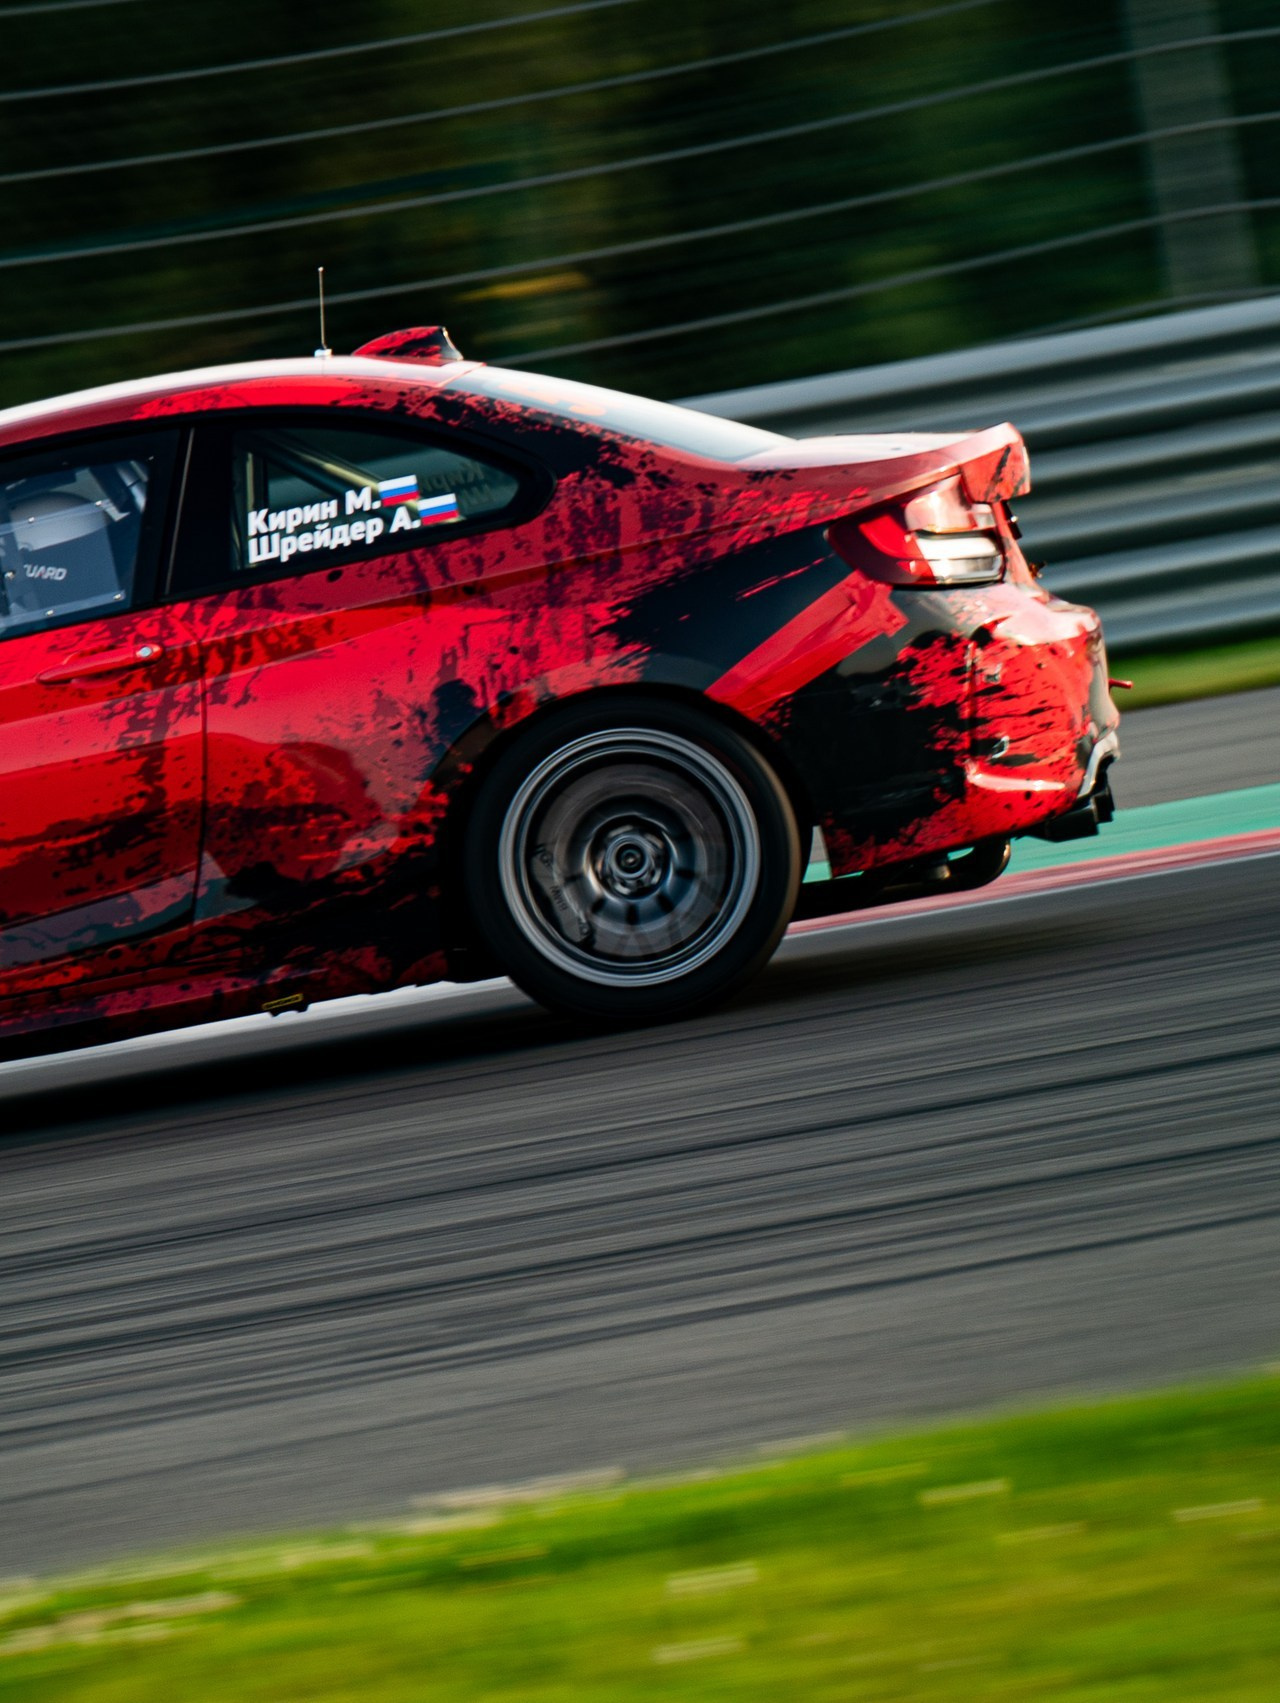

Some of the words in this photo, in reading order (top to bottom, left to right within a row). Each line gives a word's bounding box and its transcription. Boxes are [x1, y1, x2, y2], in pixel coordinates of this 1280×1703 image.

[247, 498, 338, 537] Кирин
[345, 486, 382, 516] М.
[247, 517, 385, 564] Шрейдер
[389, 506, 421, 534] А.
